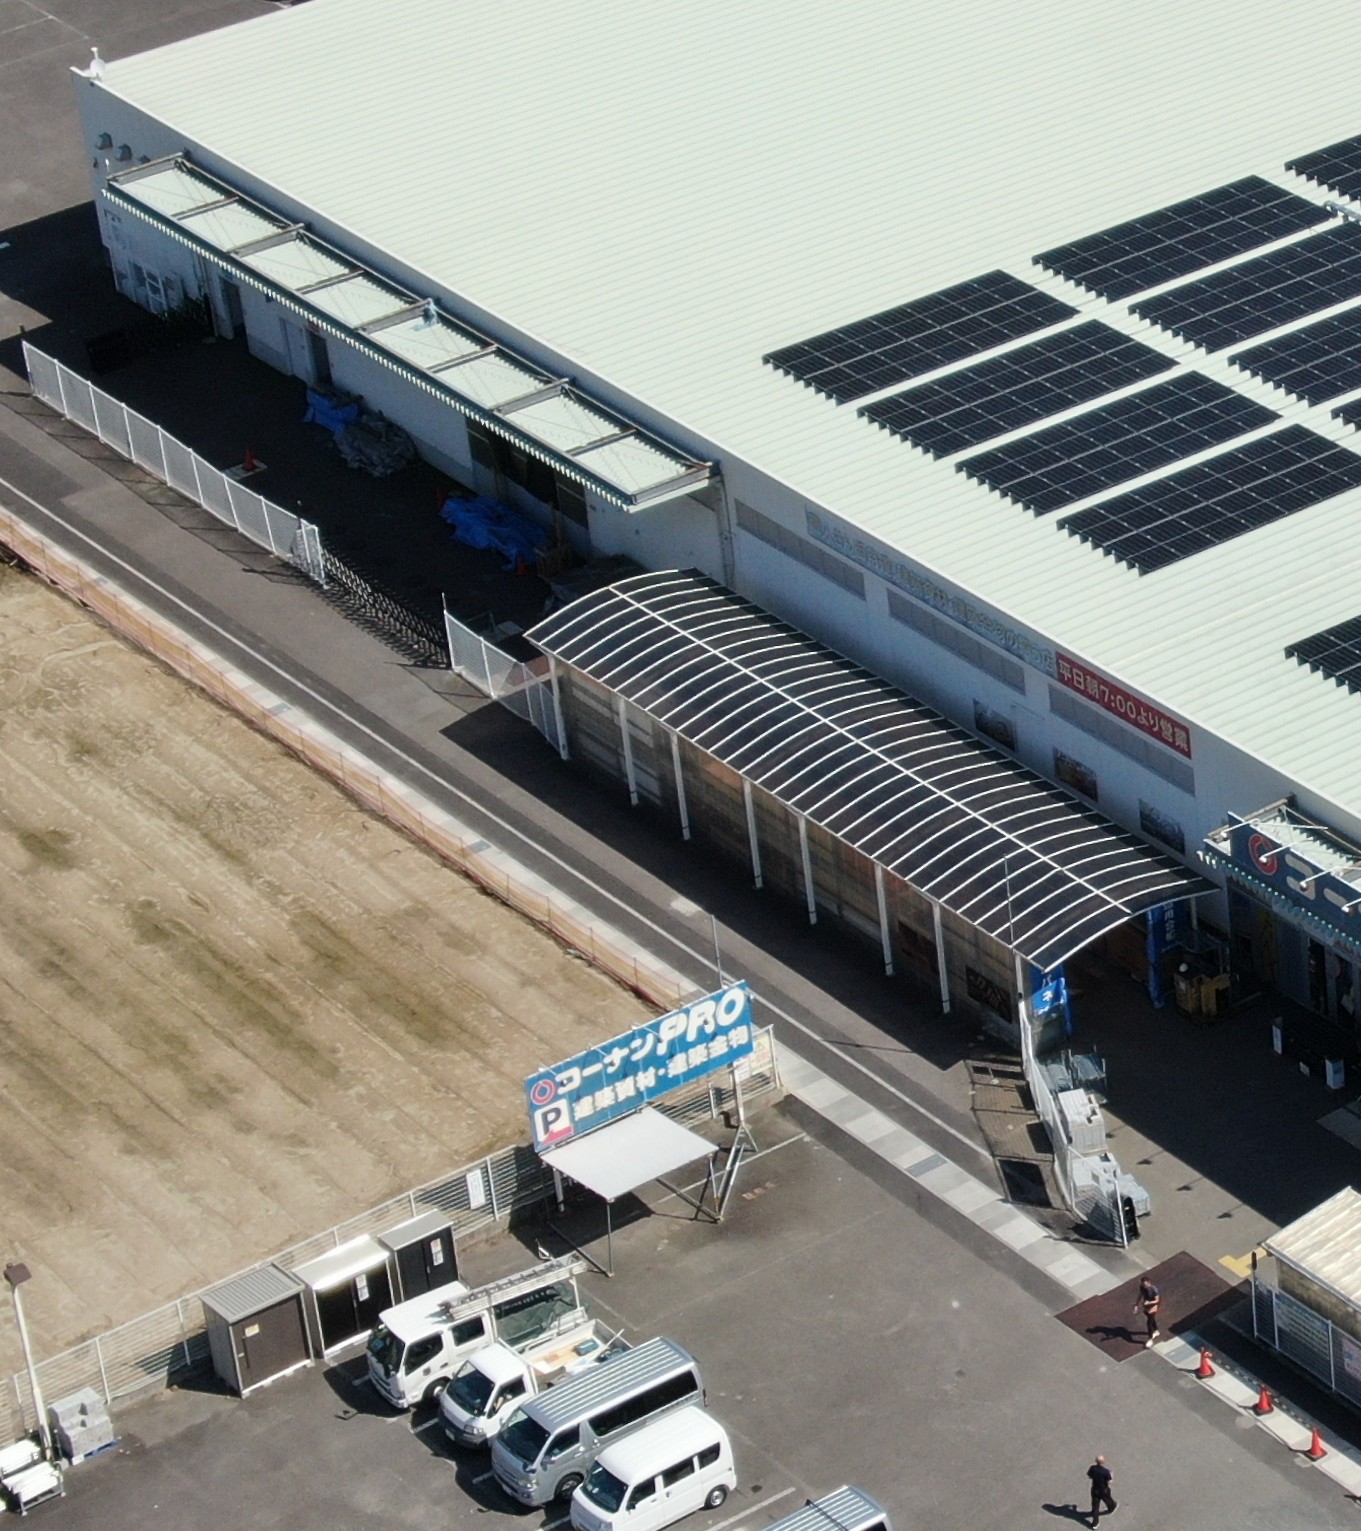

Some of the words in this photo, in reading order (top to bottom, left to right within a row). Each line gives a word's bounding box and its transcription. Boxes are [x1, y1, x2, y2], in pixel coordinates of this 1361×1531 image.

[1058, 659, 1188, 751] 平日朝7:00より営業
[554, 987, 745, 1095] コーナンPRO
[541, 1106, 562, 1136] P
